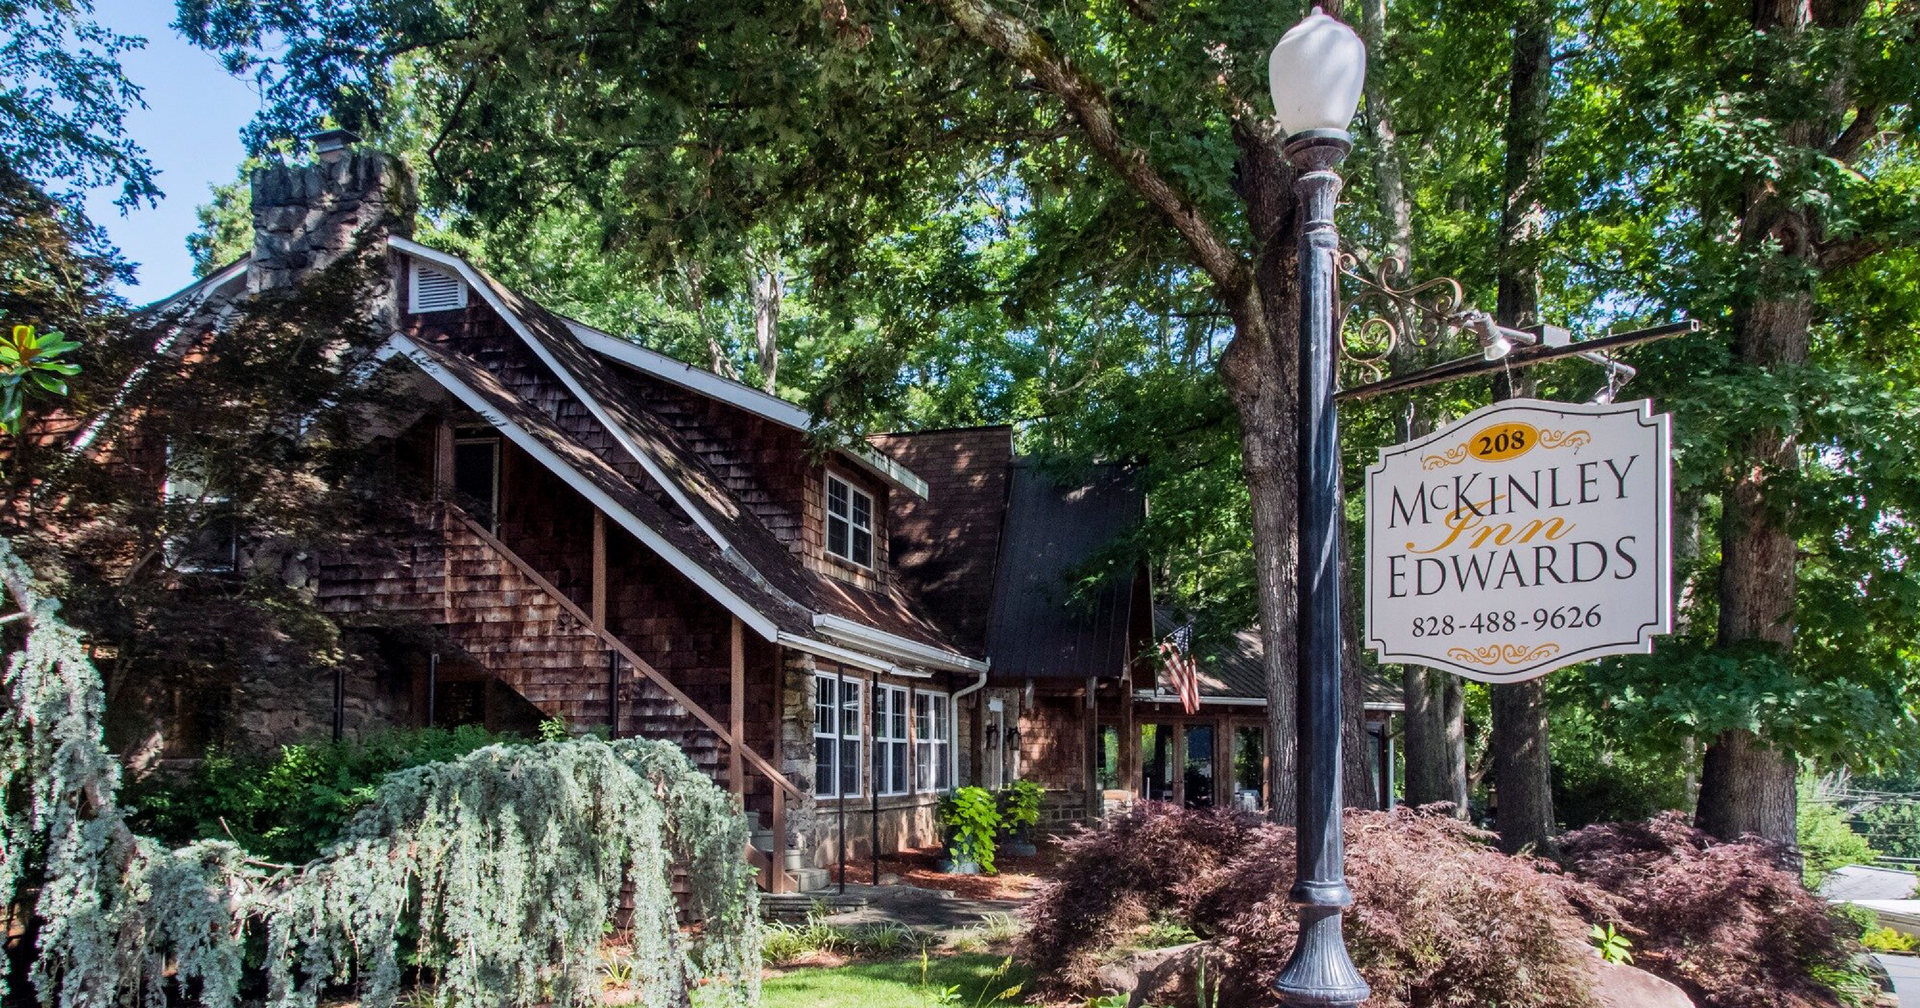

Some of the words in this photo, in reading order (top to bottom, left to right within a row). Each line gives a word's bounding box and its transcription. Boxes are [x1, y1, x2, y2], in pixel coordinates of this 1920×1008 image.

[1478, 430, 1525, 456] 208
[1405, 494, 1577, 554] Inn
[1387, 535, 1638, 599] EDWARDS
[1411, 603, 1602, 638] 828-488-9626
